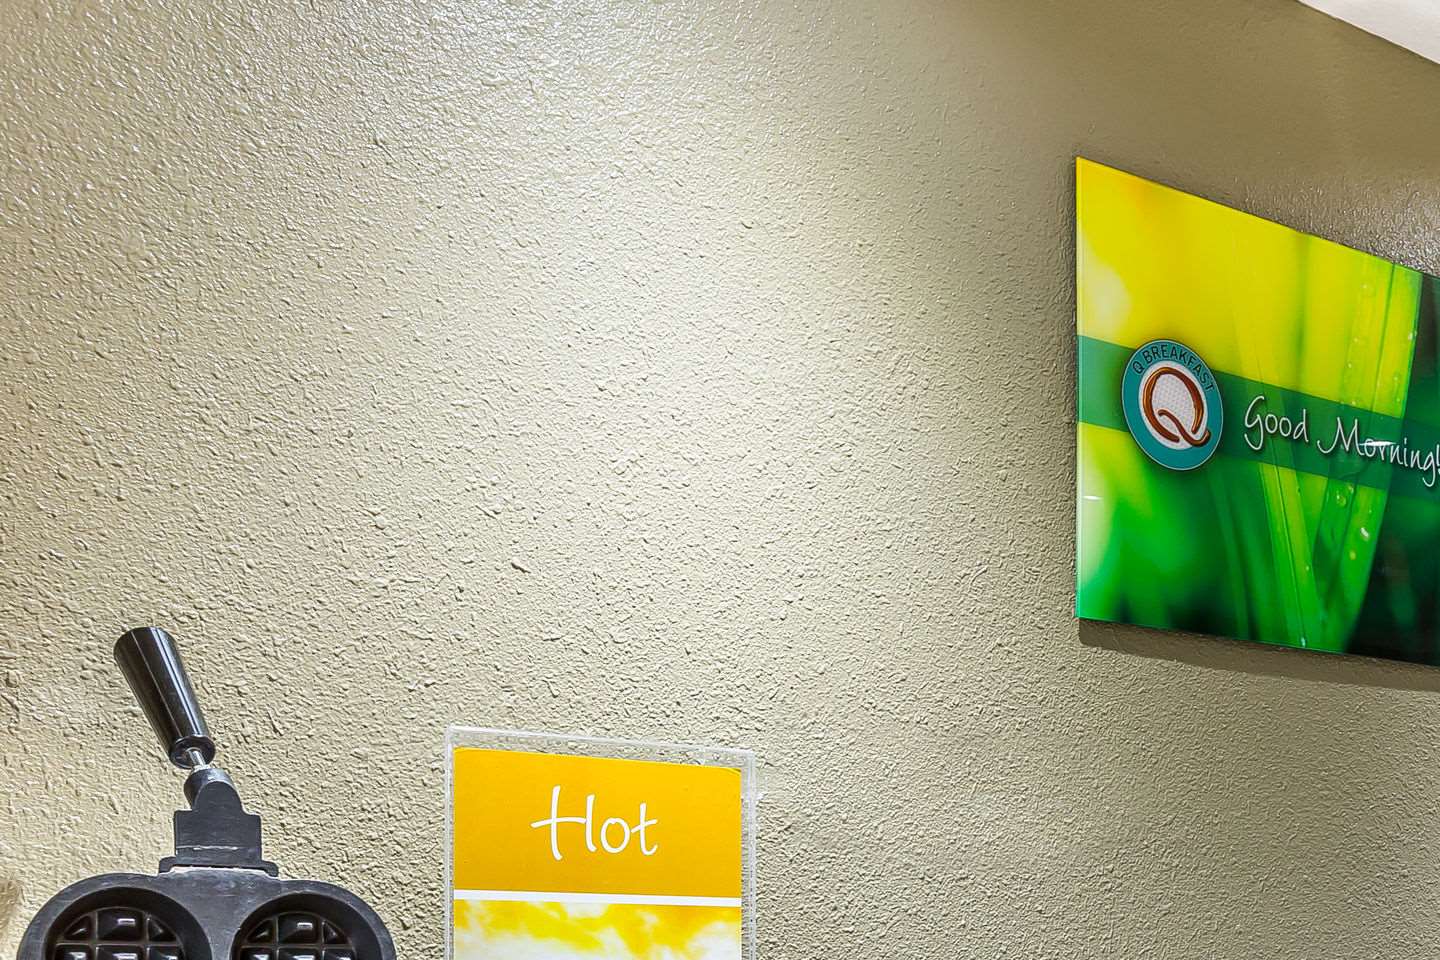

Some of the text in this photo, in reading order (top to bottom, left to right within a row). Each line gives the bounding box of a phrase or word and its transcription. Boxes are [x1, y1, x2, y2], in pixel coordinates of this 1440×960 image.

[1132, 344, 1215, 393] Q BREAKFAST
[1142, 366, 1211, 447] Q
[1244, 396, 1309, 451] Good
[530, 785, 658, 861] Hot
